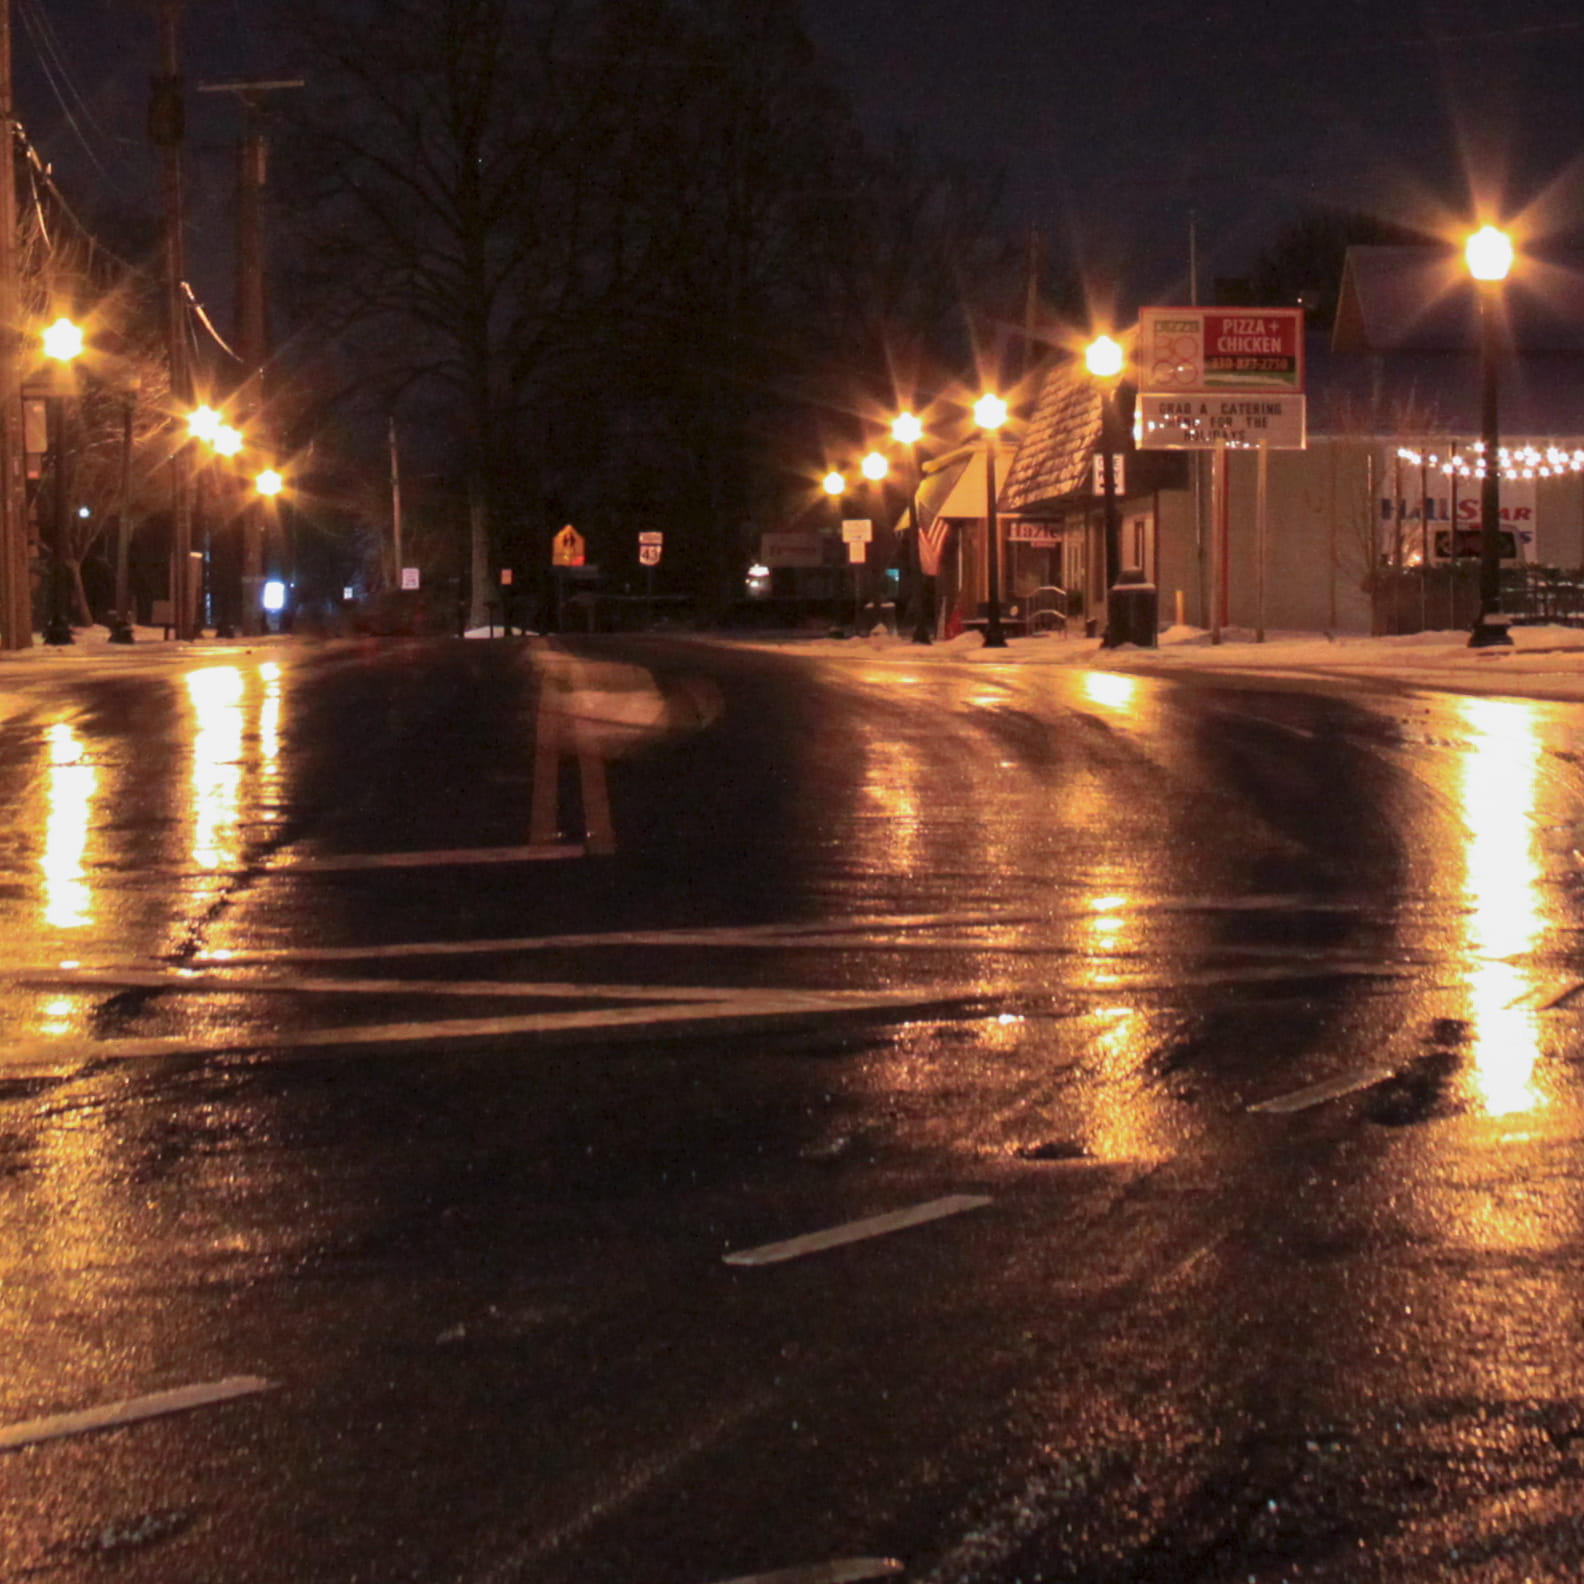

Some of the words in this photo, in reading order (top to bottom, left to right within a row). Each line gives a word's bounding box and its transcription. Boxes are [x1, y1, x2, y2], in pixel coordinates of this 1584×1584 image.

[1222, 318, 1266, 335] PIZZA
[1217, 336, 1283, 353] CHICKEN
[1159, 402, 1192, 415] GRAB
[1200, 403, 1208, 415] A
[1220, 402, 1282, 415] CATERING
[1210, 417, 1233, 428] FOR
[1246, 417, 1268, 429] THE
